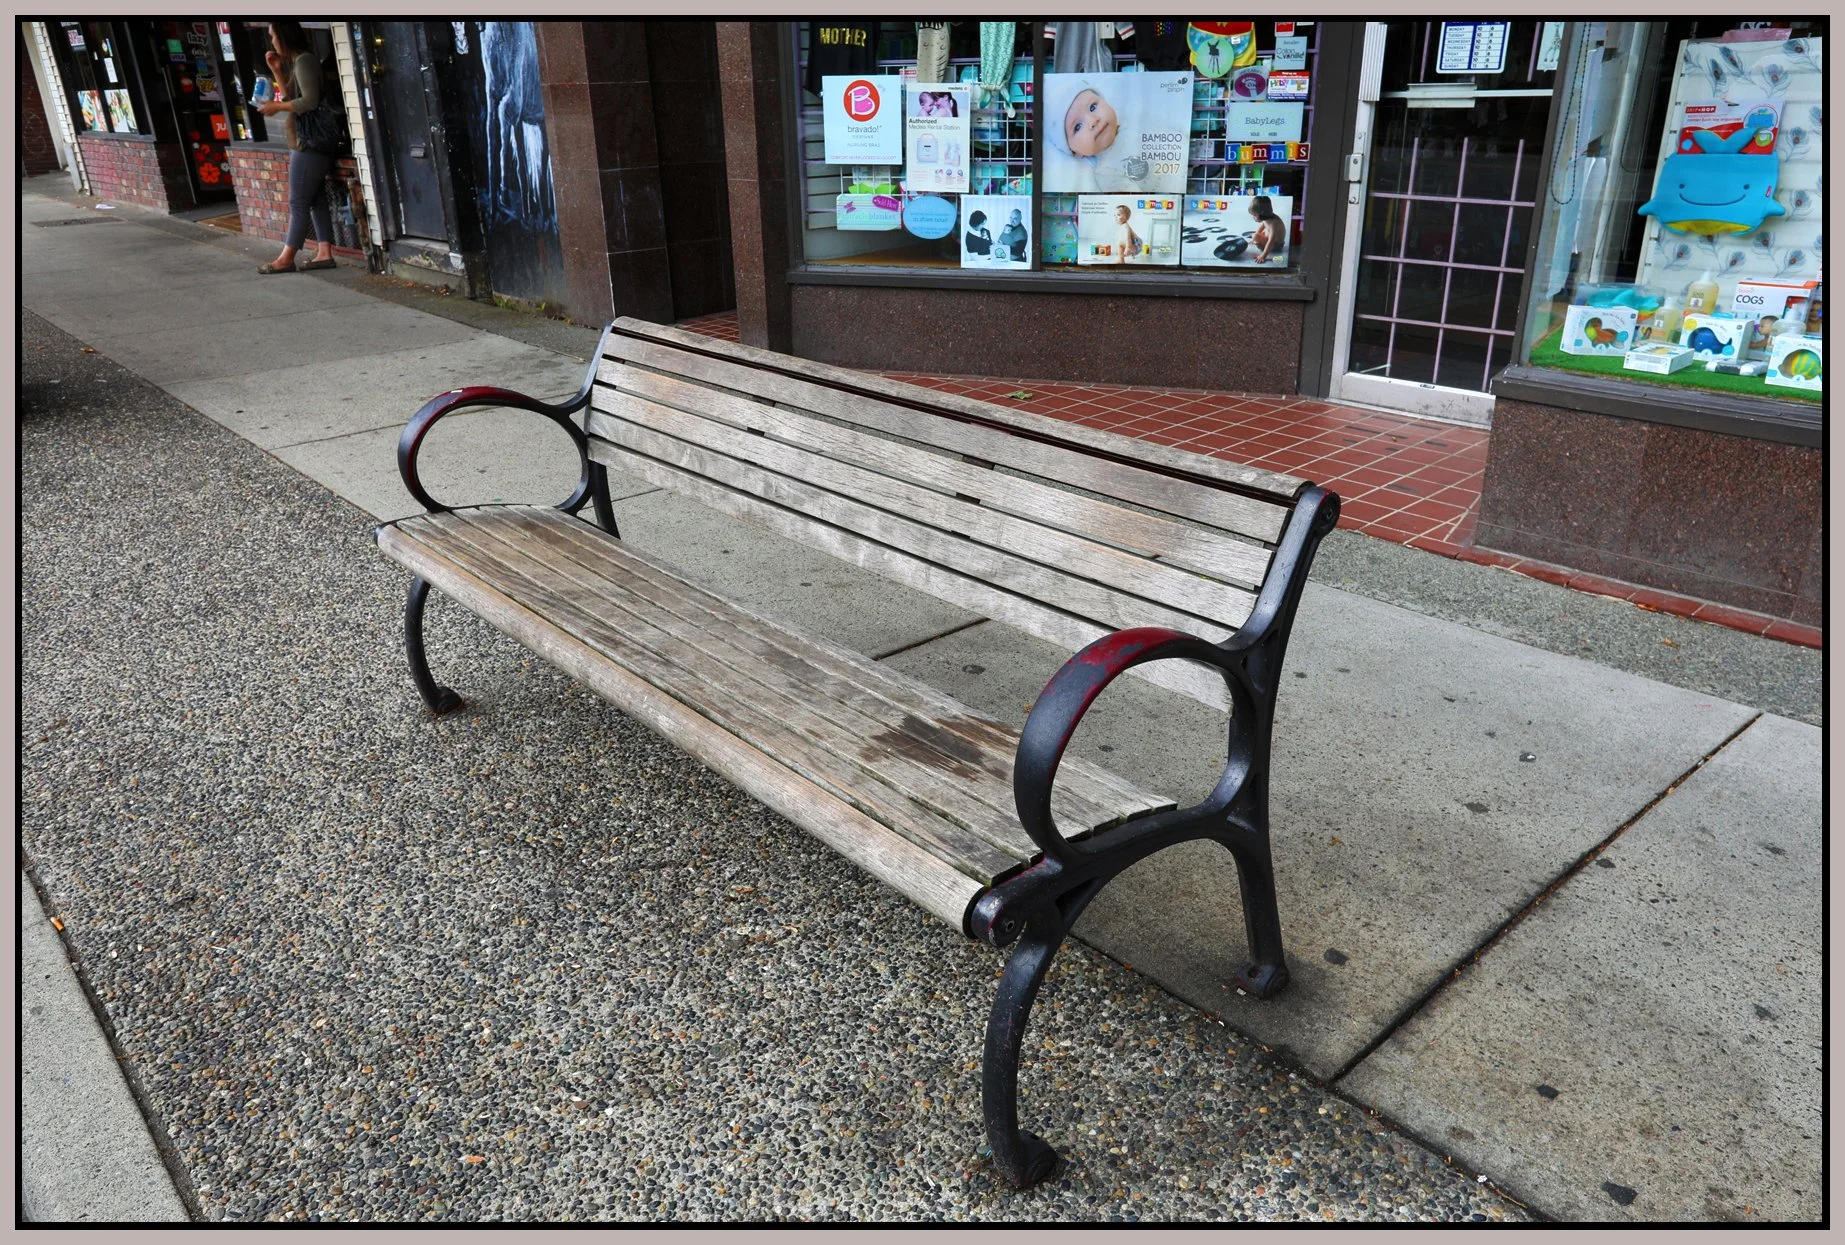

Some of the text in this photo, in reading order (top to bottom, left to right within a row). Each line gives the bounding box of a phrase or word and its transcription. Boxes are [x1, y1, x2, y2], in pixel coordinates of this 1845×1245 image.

[820, 28, 867, 47] MOTHER
[1245, 117, 1285, 126] BabyLegs
[1141, 133, 1183, 143] BAMBOO
[1141, 143, 1182, 151] COLLECTION
[1141, 152, 1182, 161] BAMBOU
[1226, 144, 1307, 161] bummis
[1154, 163, 1181, 174] 2017
[1138, 200, 1174, 210] bummis
[868, 212, 897, 220] blanket
[1735, 294, 1765, 305] COGS
